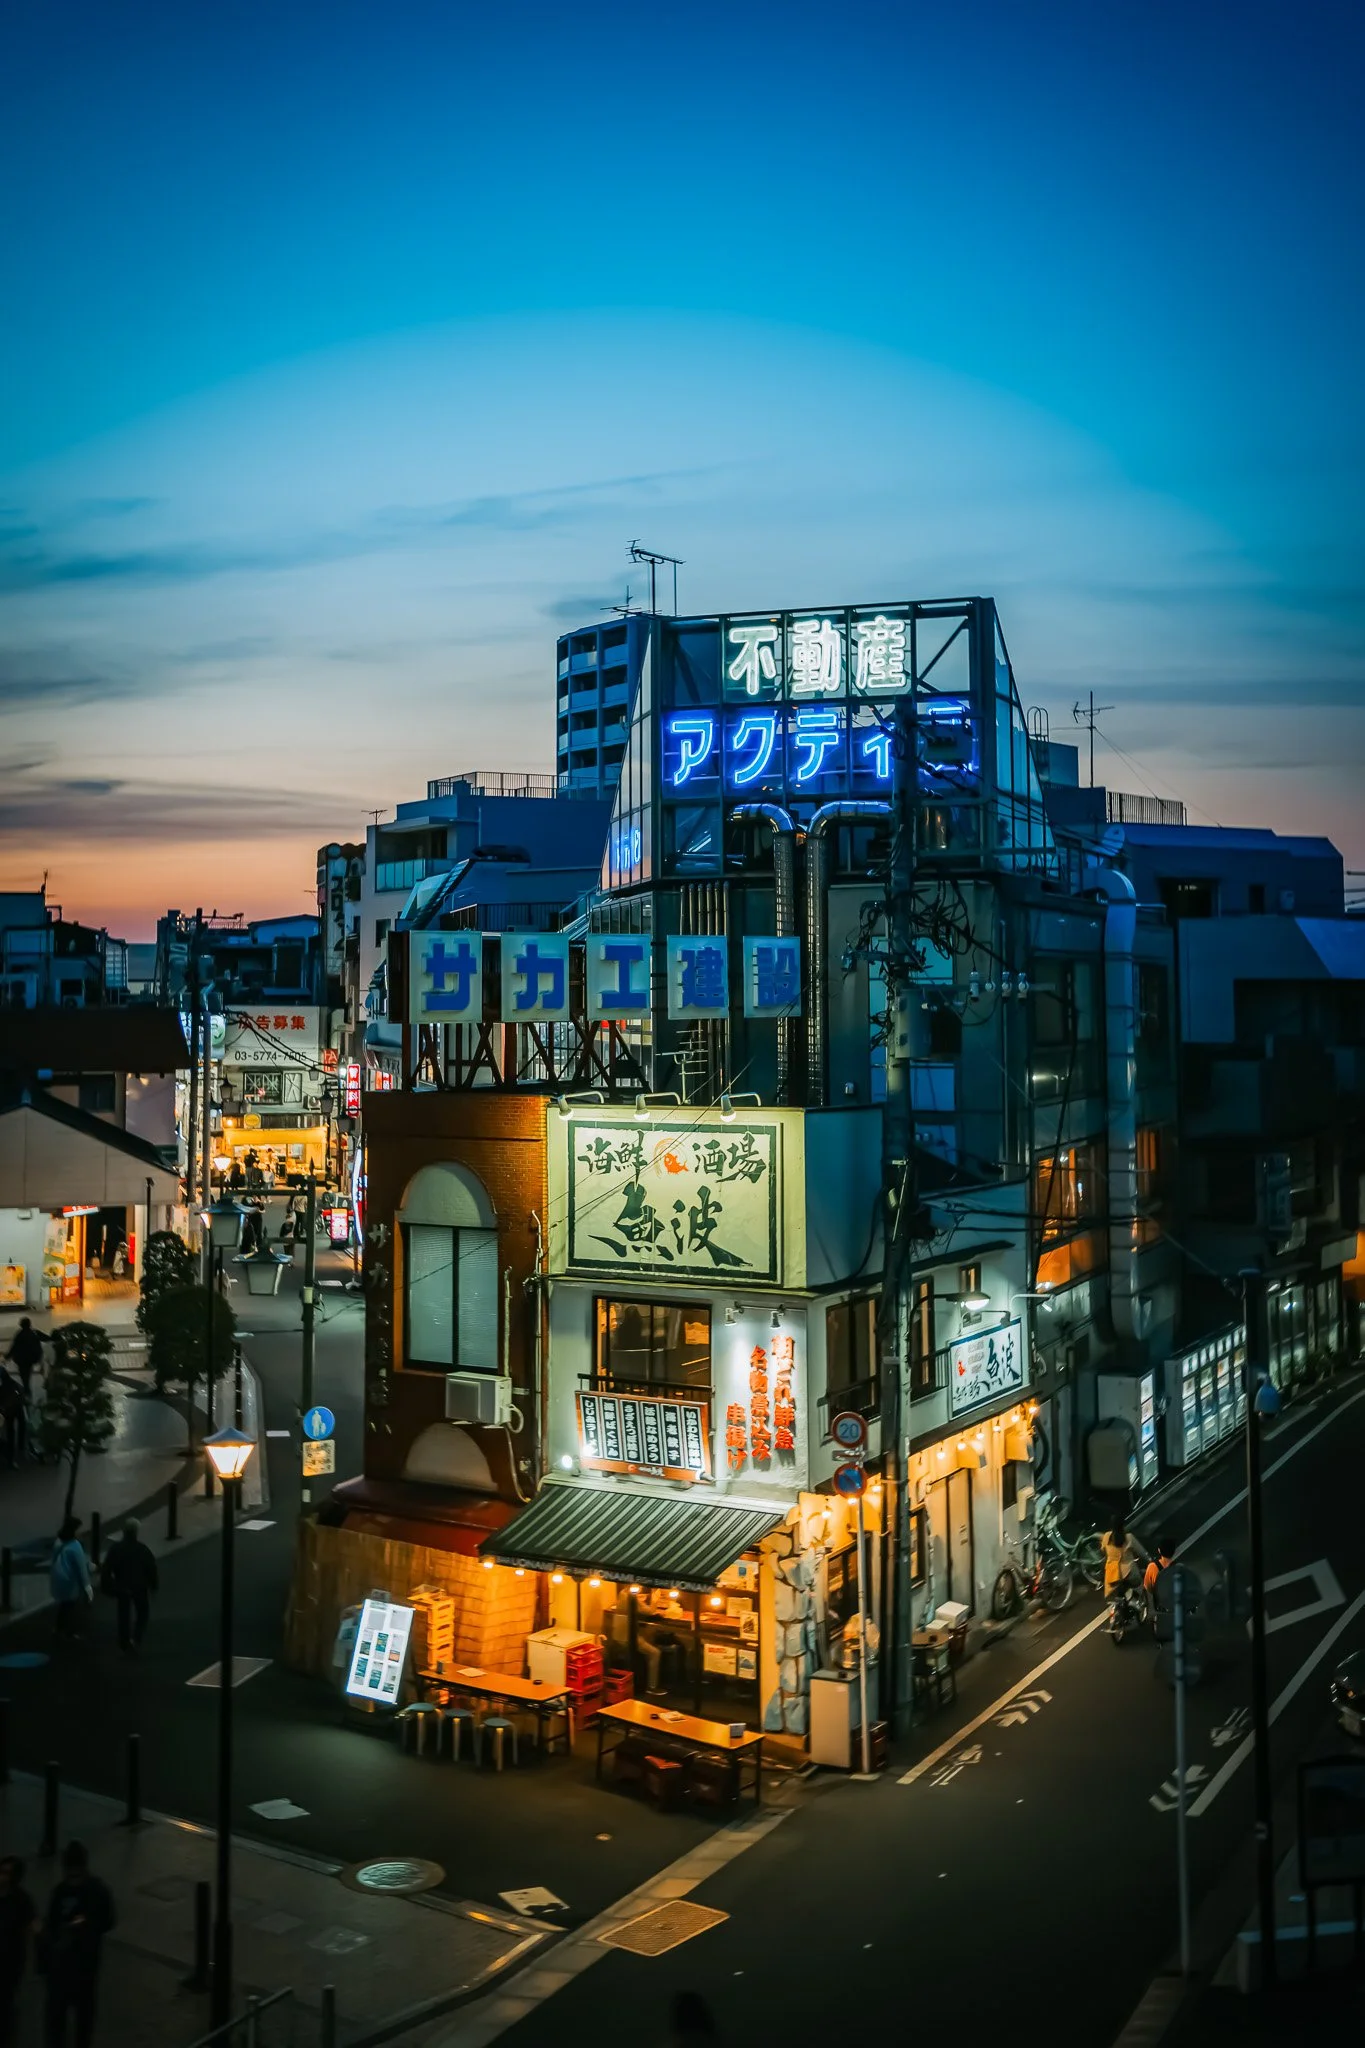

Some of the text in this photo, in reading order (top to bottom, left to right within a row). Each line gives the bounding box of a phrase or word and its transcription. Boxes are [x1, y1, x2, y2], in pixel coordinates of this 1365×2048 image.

[728, 615, 907, 695] 不動産
[424, 940, 800, 1015] サカエ建設
[578, 1130, 767, 1186] 海鮮 酒場
[588, 1181, 753, 1267] 魚波
[726, 1402, 748, 1470] 串揚げ
[749, 1344, 771, 1461] 名物煮込み
[839, 1423, 859, 1438] 20
